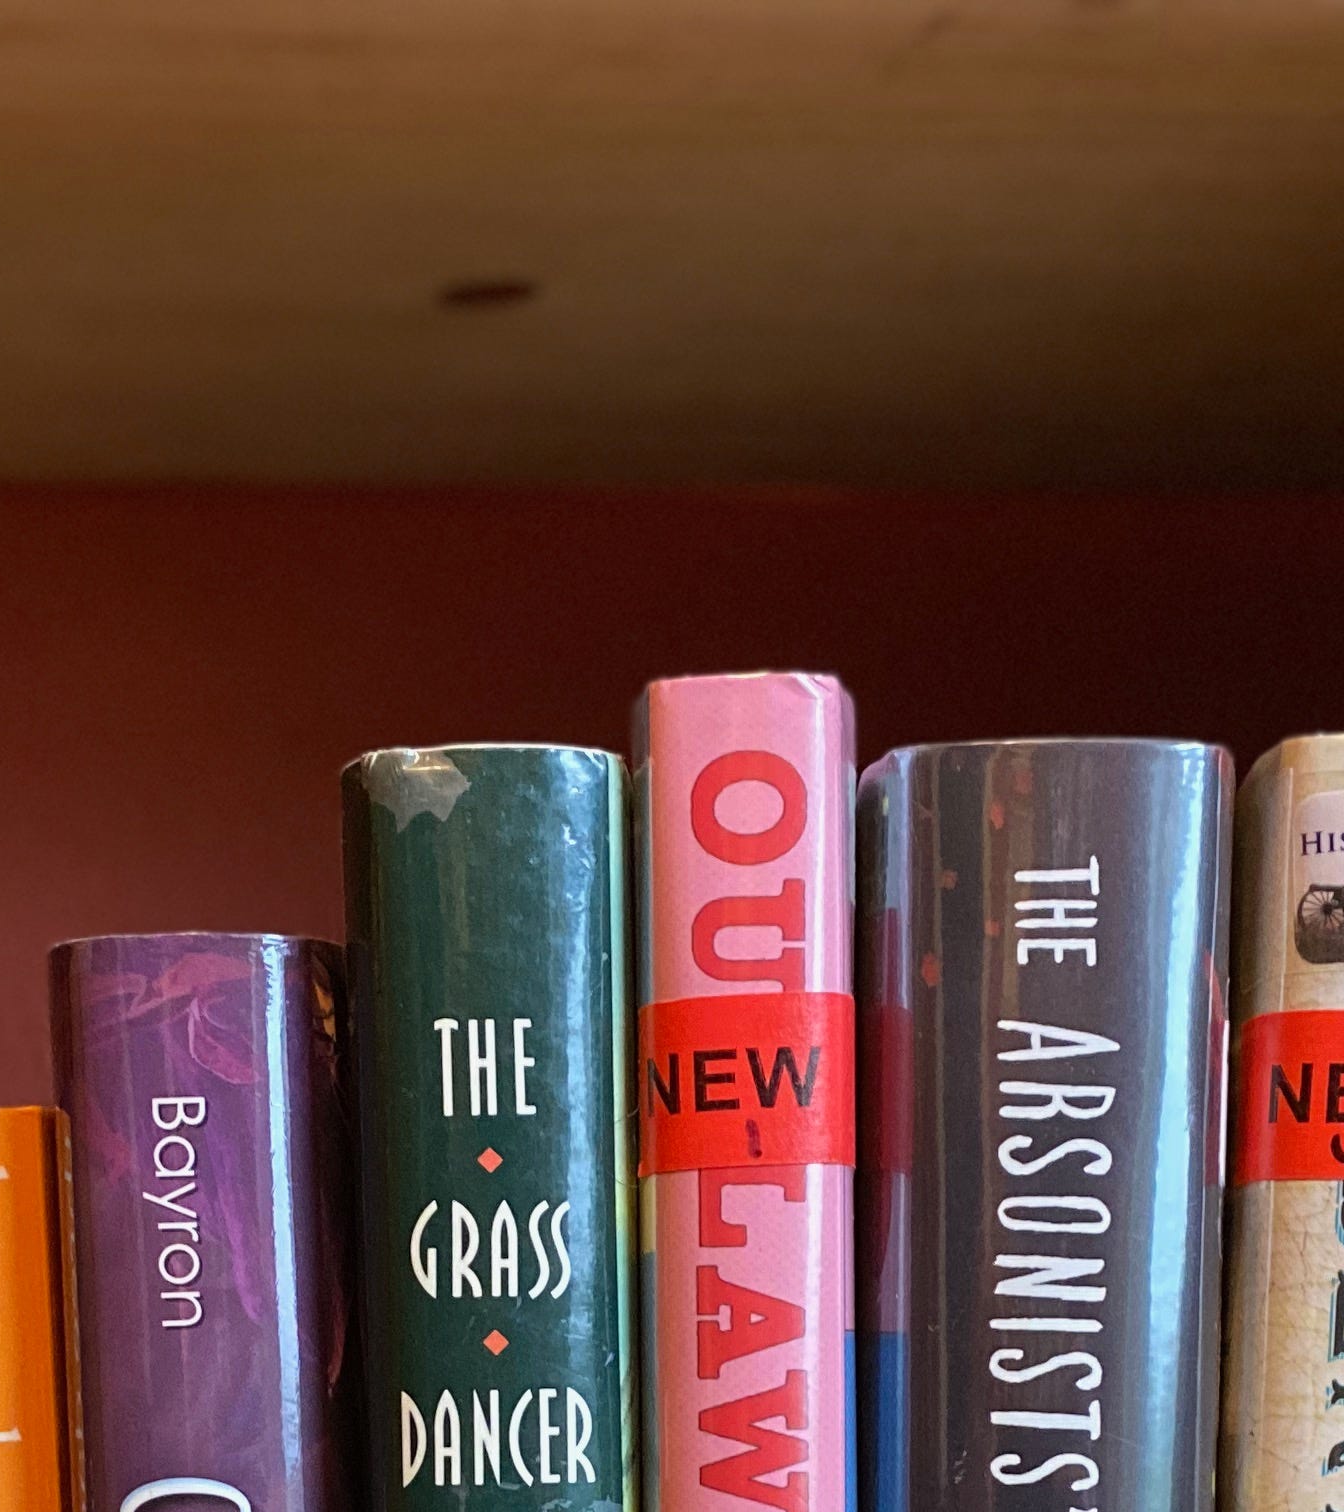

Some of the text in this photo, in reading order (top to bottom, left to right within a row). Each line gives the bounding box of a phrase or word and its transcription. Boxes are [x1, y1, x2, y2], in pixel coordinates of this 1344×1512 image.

[1014, 855, 1100, 966] THE
[433, 1017, 537, 1117] THE
[647, 1046, 821, 1117] NEW
[142, 1096, 204, 1328] Bayron
[411, 1200, 570, 1300] GRASS
[401, 1388, 596, 1488] DANCER
